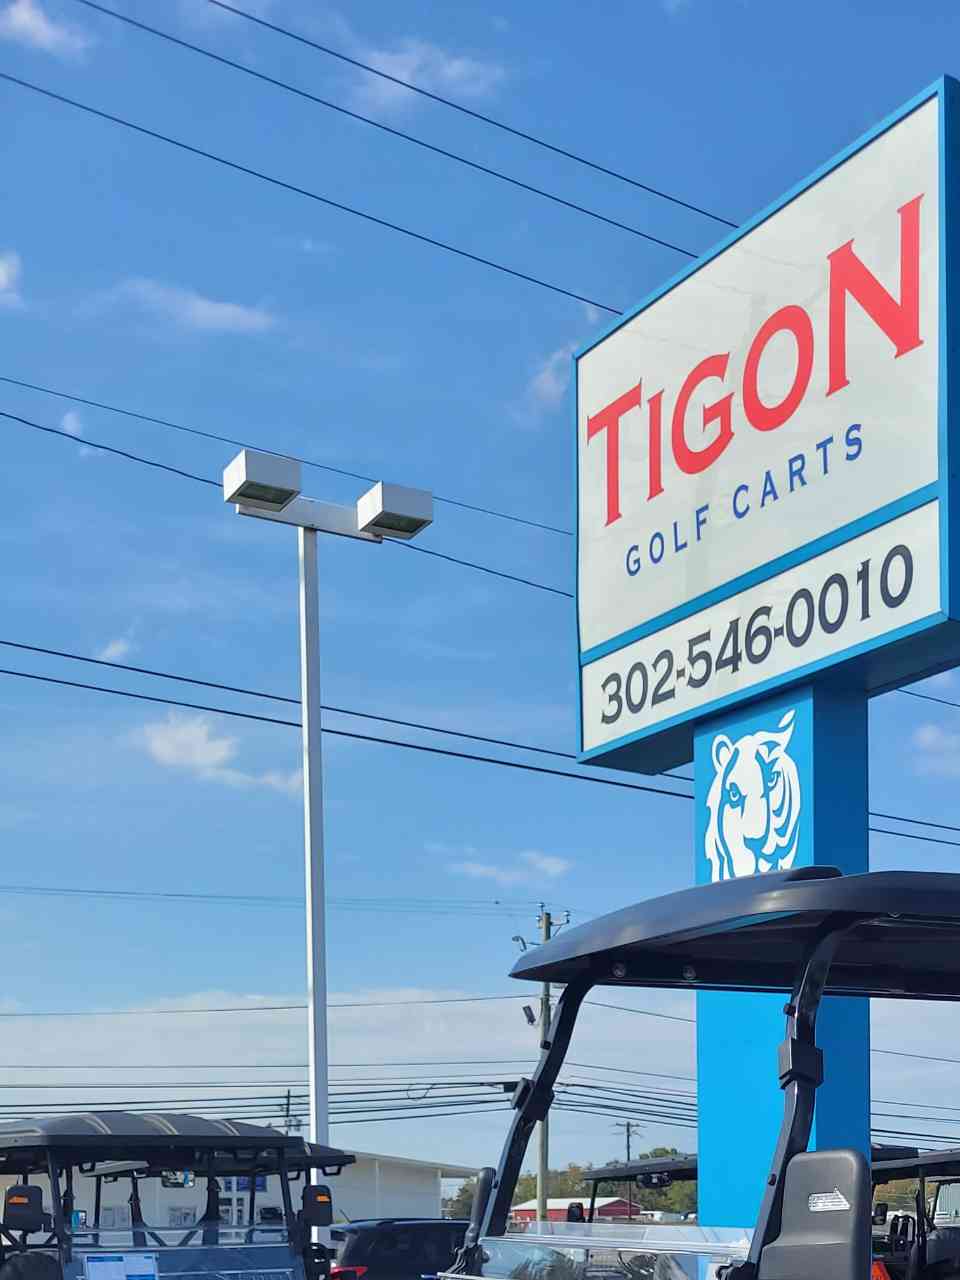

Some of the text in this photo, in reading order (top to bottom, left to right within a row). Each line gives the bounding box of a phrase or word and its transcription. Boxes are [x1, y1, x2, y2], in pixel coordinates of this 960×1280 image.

[587, 194, 923, 524] TIGON
[625, 423, 864, 577] GOLF CARTS
[600, 544, 914, 726] 302-546-0010
